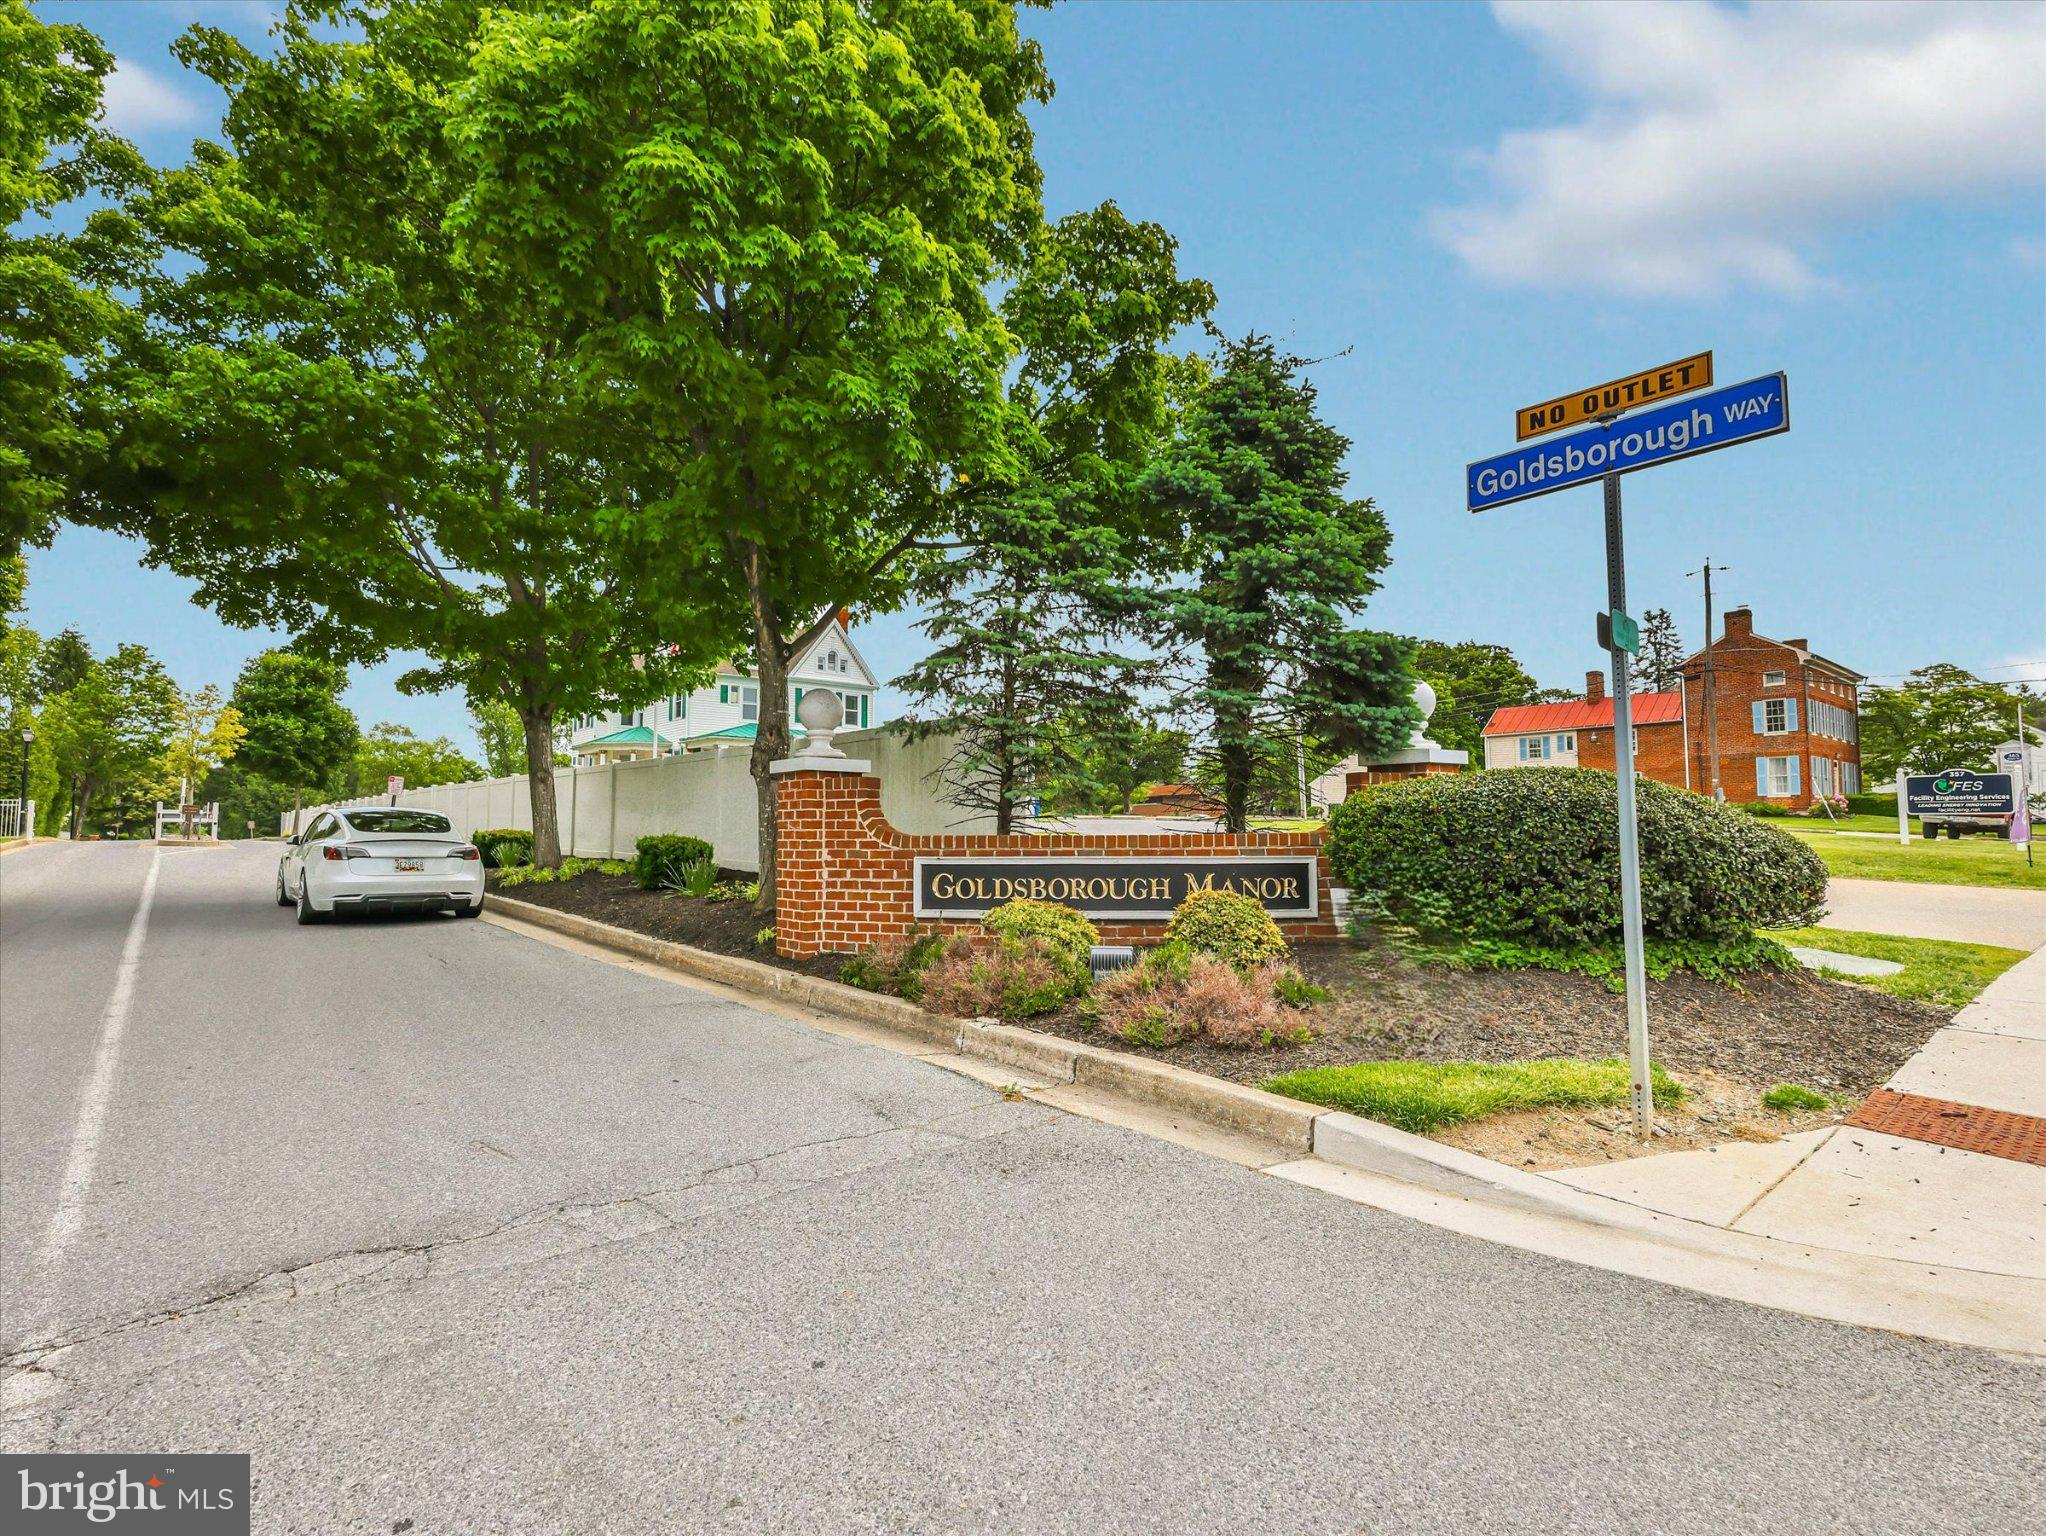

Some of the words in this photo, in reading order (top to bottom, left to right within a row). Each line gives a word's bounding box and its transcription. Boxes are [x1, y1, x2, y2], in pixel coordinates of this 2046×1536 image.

[1529, 404, 1566, 431] NO
[1582, 363, 1697, 414] OUTLET
[1476, 408, 1714, 497] Goldsborough
[1723, 392, 1774, 425] WAY
[1909, 794, 1935, 802] Facility
[1935, 794, 1978, 802] Engineering
[1979, 793, 2010, 801] Services
[1952, 780, 1984, 792] FES
[931, 872, 1172, 900] GOLDSBOROUGH
[1183, 872, 1300, 899] MANOR
